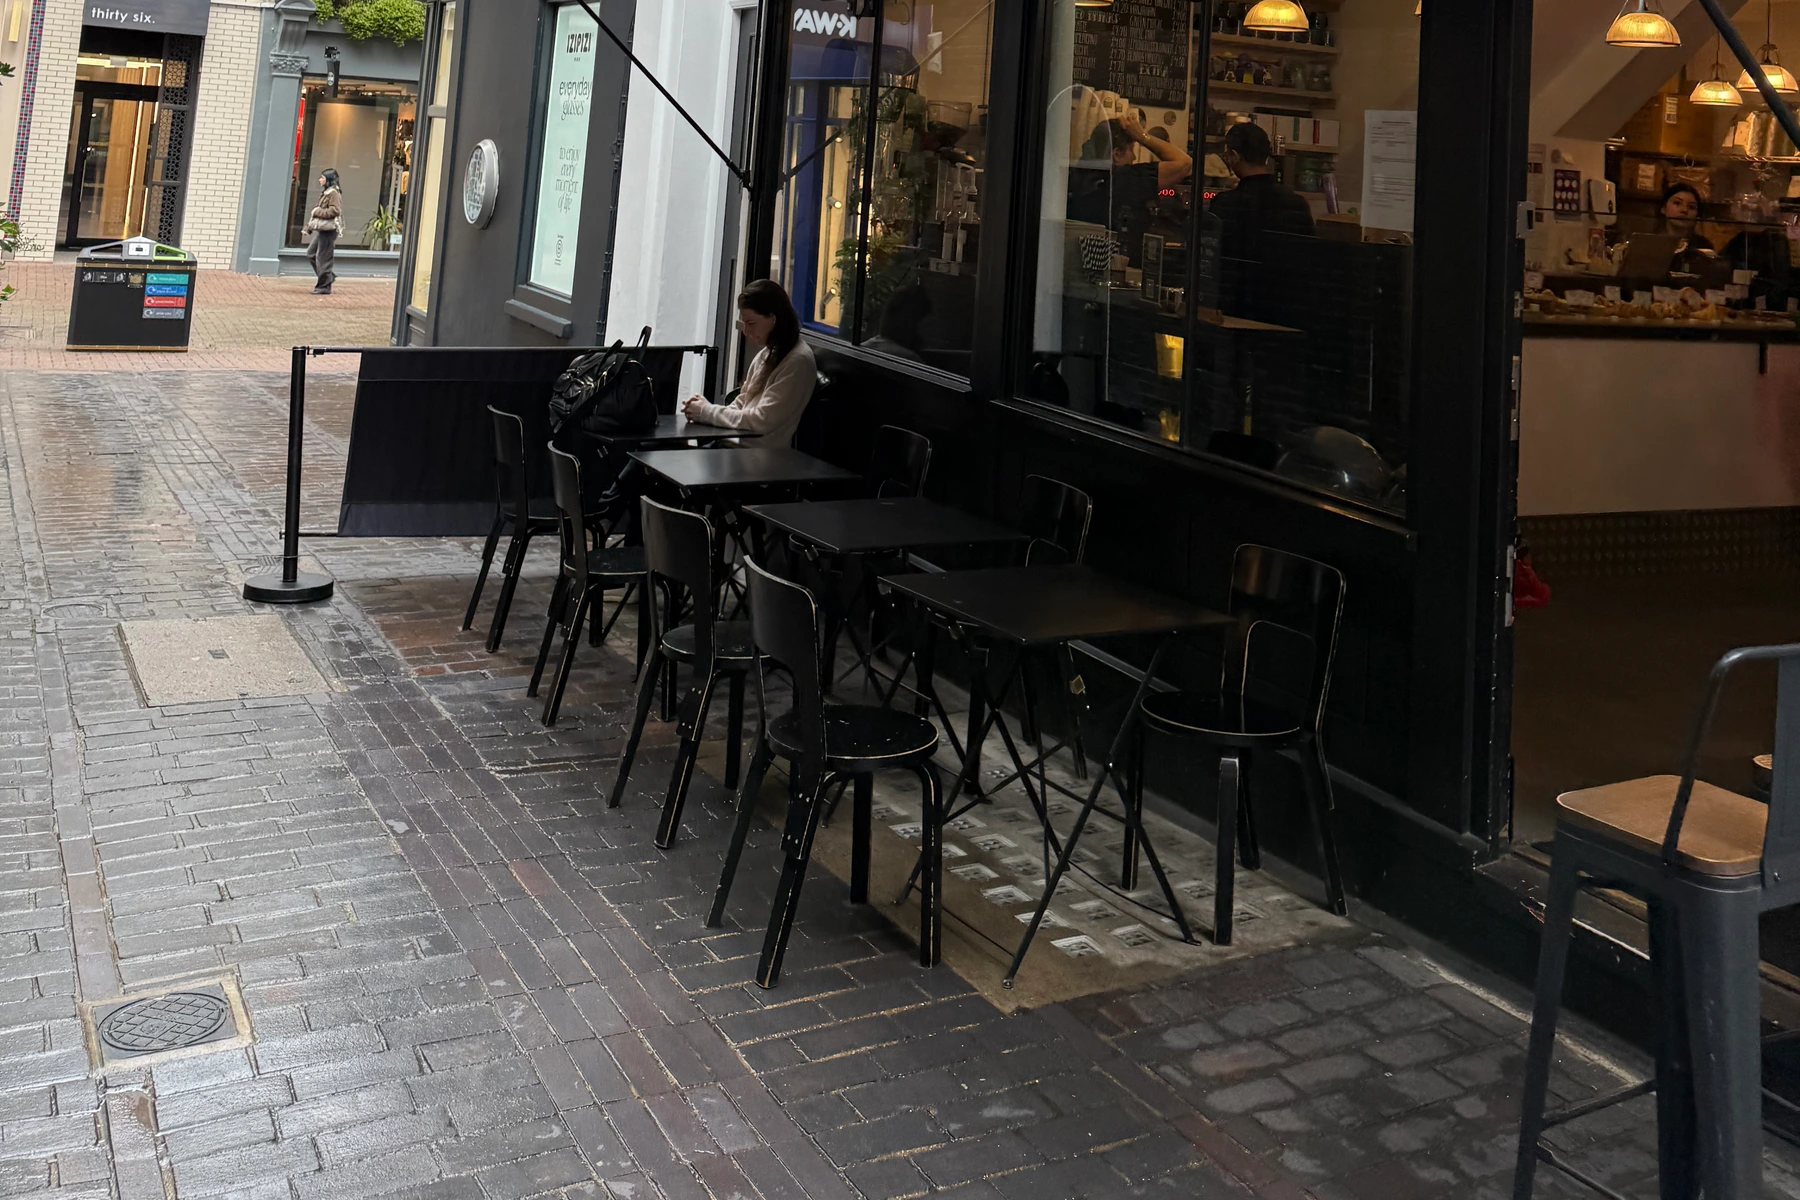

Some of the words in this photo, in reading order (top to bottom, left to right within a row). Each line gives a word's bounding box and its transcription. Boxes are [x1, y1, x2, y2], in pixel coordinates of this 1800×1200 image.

[91, 6, 128, 24] thirty
[132, 11, 156, 24] six.
[566, 32, 592, 53] IZIPIZI
[559, 76, 592, 100] everyday
[561, 98, 585, 121] glasses
[559, 147, 565, 160] to
[565, 145, 581, 164] enjoy
[561, 163, 578, 180] every
[555, 178, 578, 194] moment
